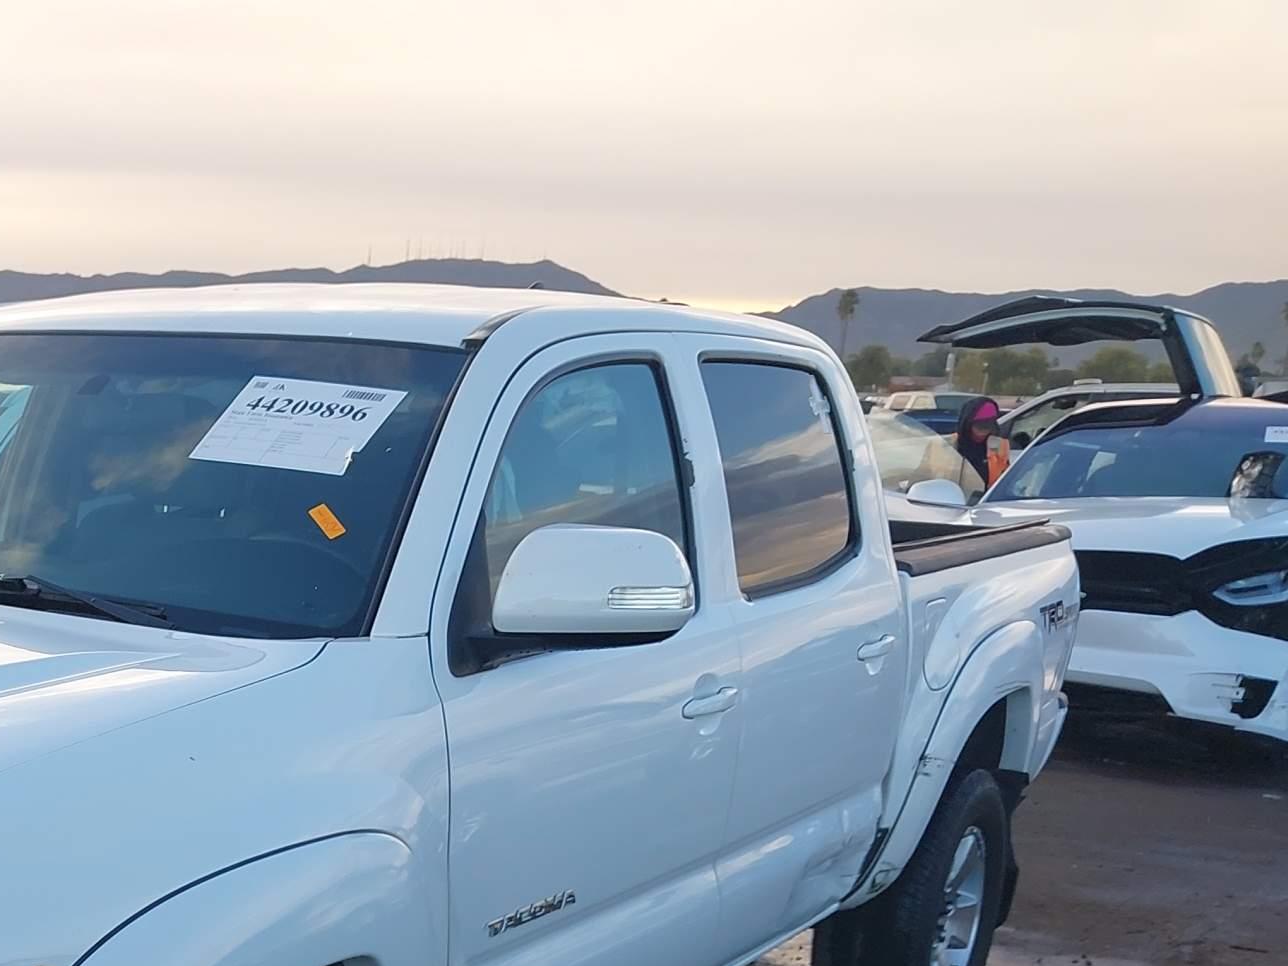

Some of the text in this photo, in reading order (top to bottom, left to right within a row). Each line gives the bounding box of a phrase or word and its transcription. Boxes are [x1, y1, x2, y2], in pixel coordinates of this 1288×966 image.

[246, 395, 373, 422] 44209896
[1040, 600, 1064, 633] TRD
[487, 889, 576, 937] TACOMA
